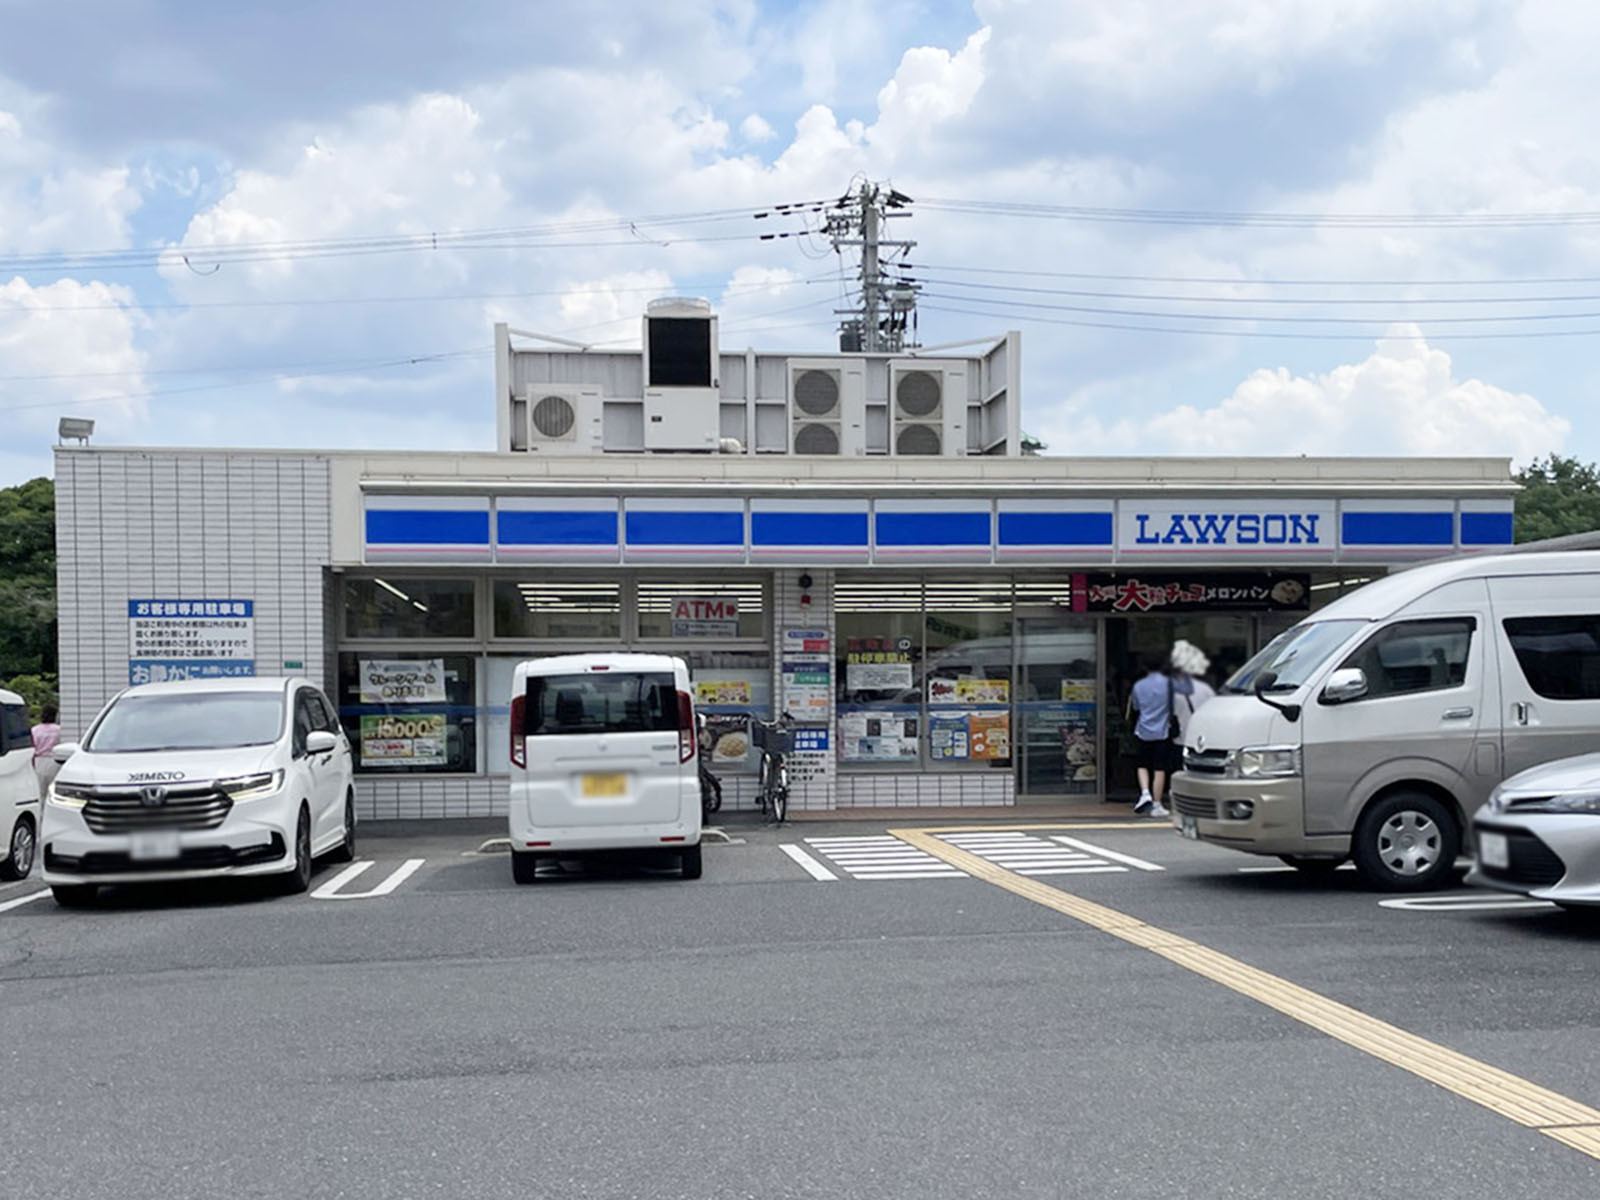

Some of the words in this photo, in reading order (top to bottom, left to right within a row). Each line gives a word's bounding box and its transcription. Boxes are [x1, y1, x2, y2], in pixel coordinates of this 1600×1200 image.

[1136, 514, 1319, 544] LAWSON
[136, 602, 246, 616] お客様専用駐車場
[675, 601, 724, 619] ATM
